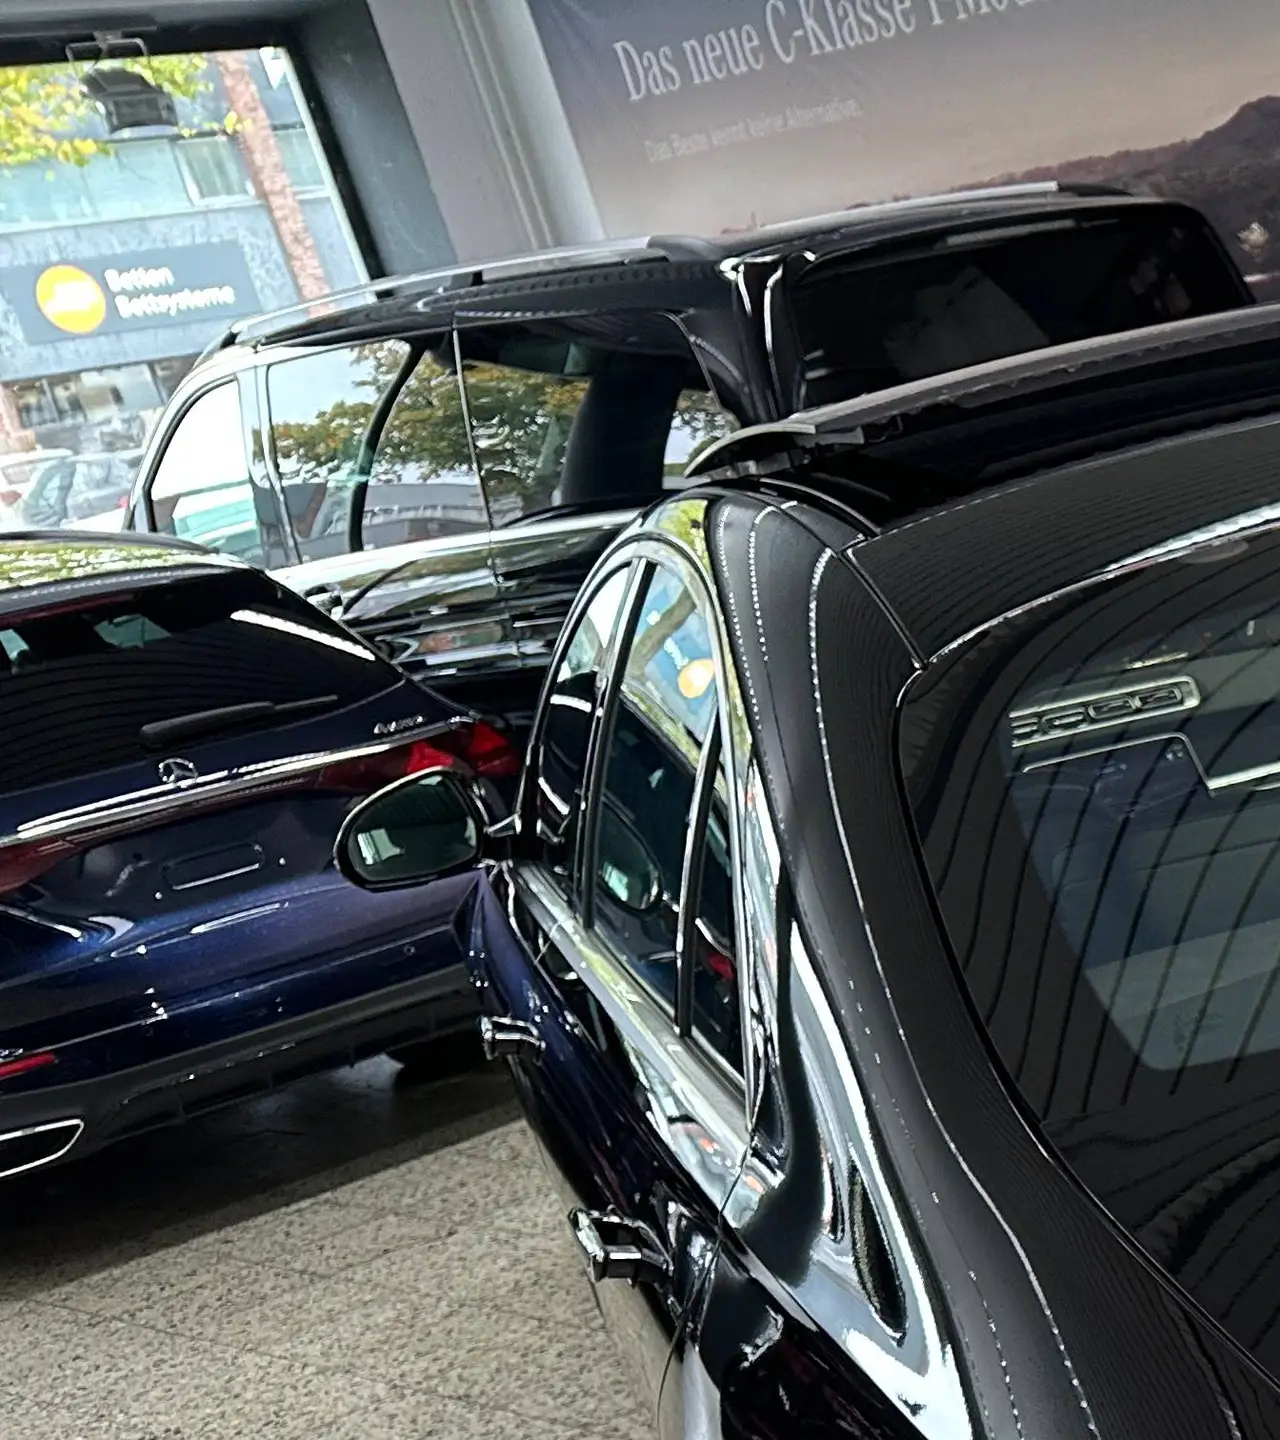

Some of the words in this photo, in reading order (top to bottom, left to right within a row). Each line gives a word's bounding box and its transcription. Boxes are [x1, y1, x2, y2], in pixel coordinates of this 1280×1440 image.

[612, 39, 682, 103] Das
[682, 23, 765, 85] neue
[764, 0, 917, 64] C-Klasse
